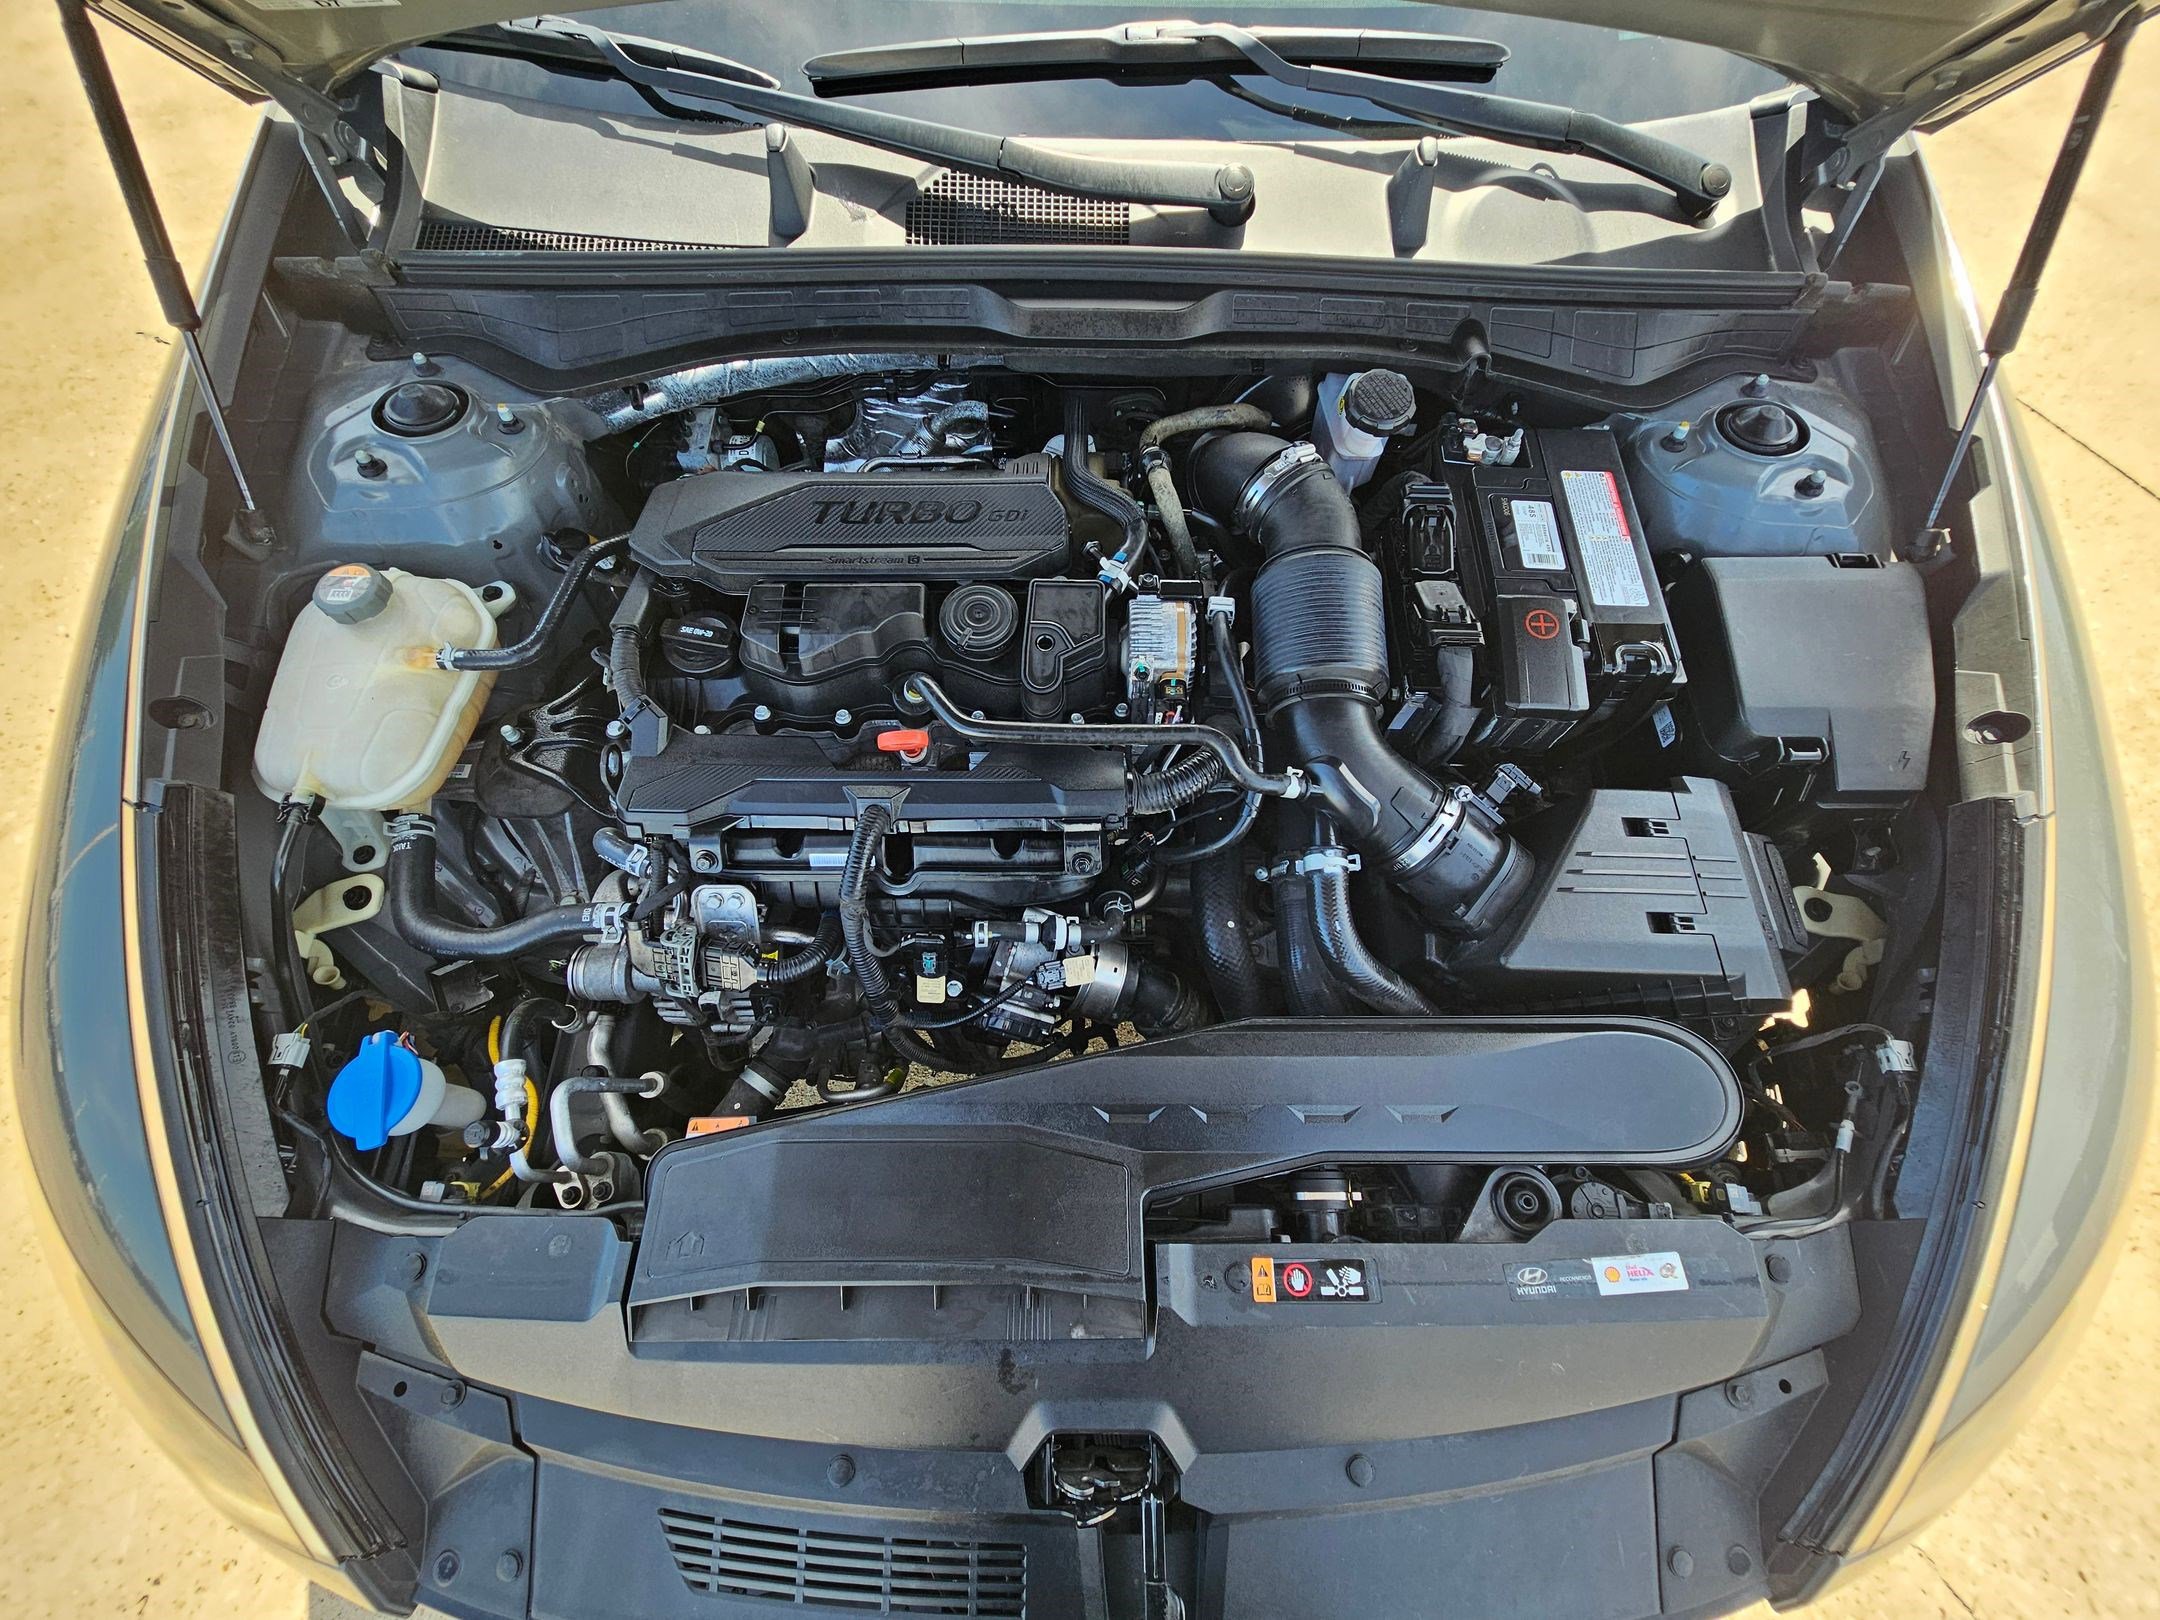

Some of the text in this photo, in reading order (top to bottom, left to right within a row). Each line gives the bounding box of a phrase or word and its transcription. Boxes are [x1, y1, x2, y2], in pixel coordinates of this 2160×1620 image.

[815, 500, 1028, 524] TURBO GDi
[825, 555, 904, 565] Smartstream
[680, 626, 713, 637] SAE 0W-20
[1626, 1267, 1655, 1278] HELIX
[1516, 1284, 1557, 1296] HYUNDAI
